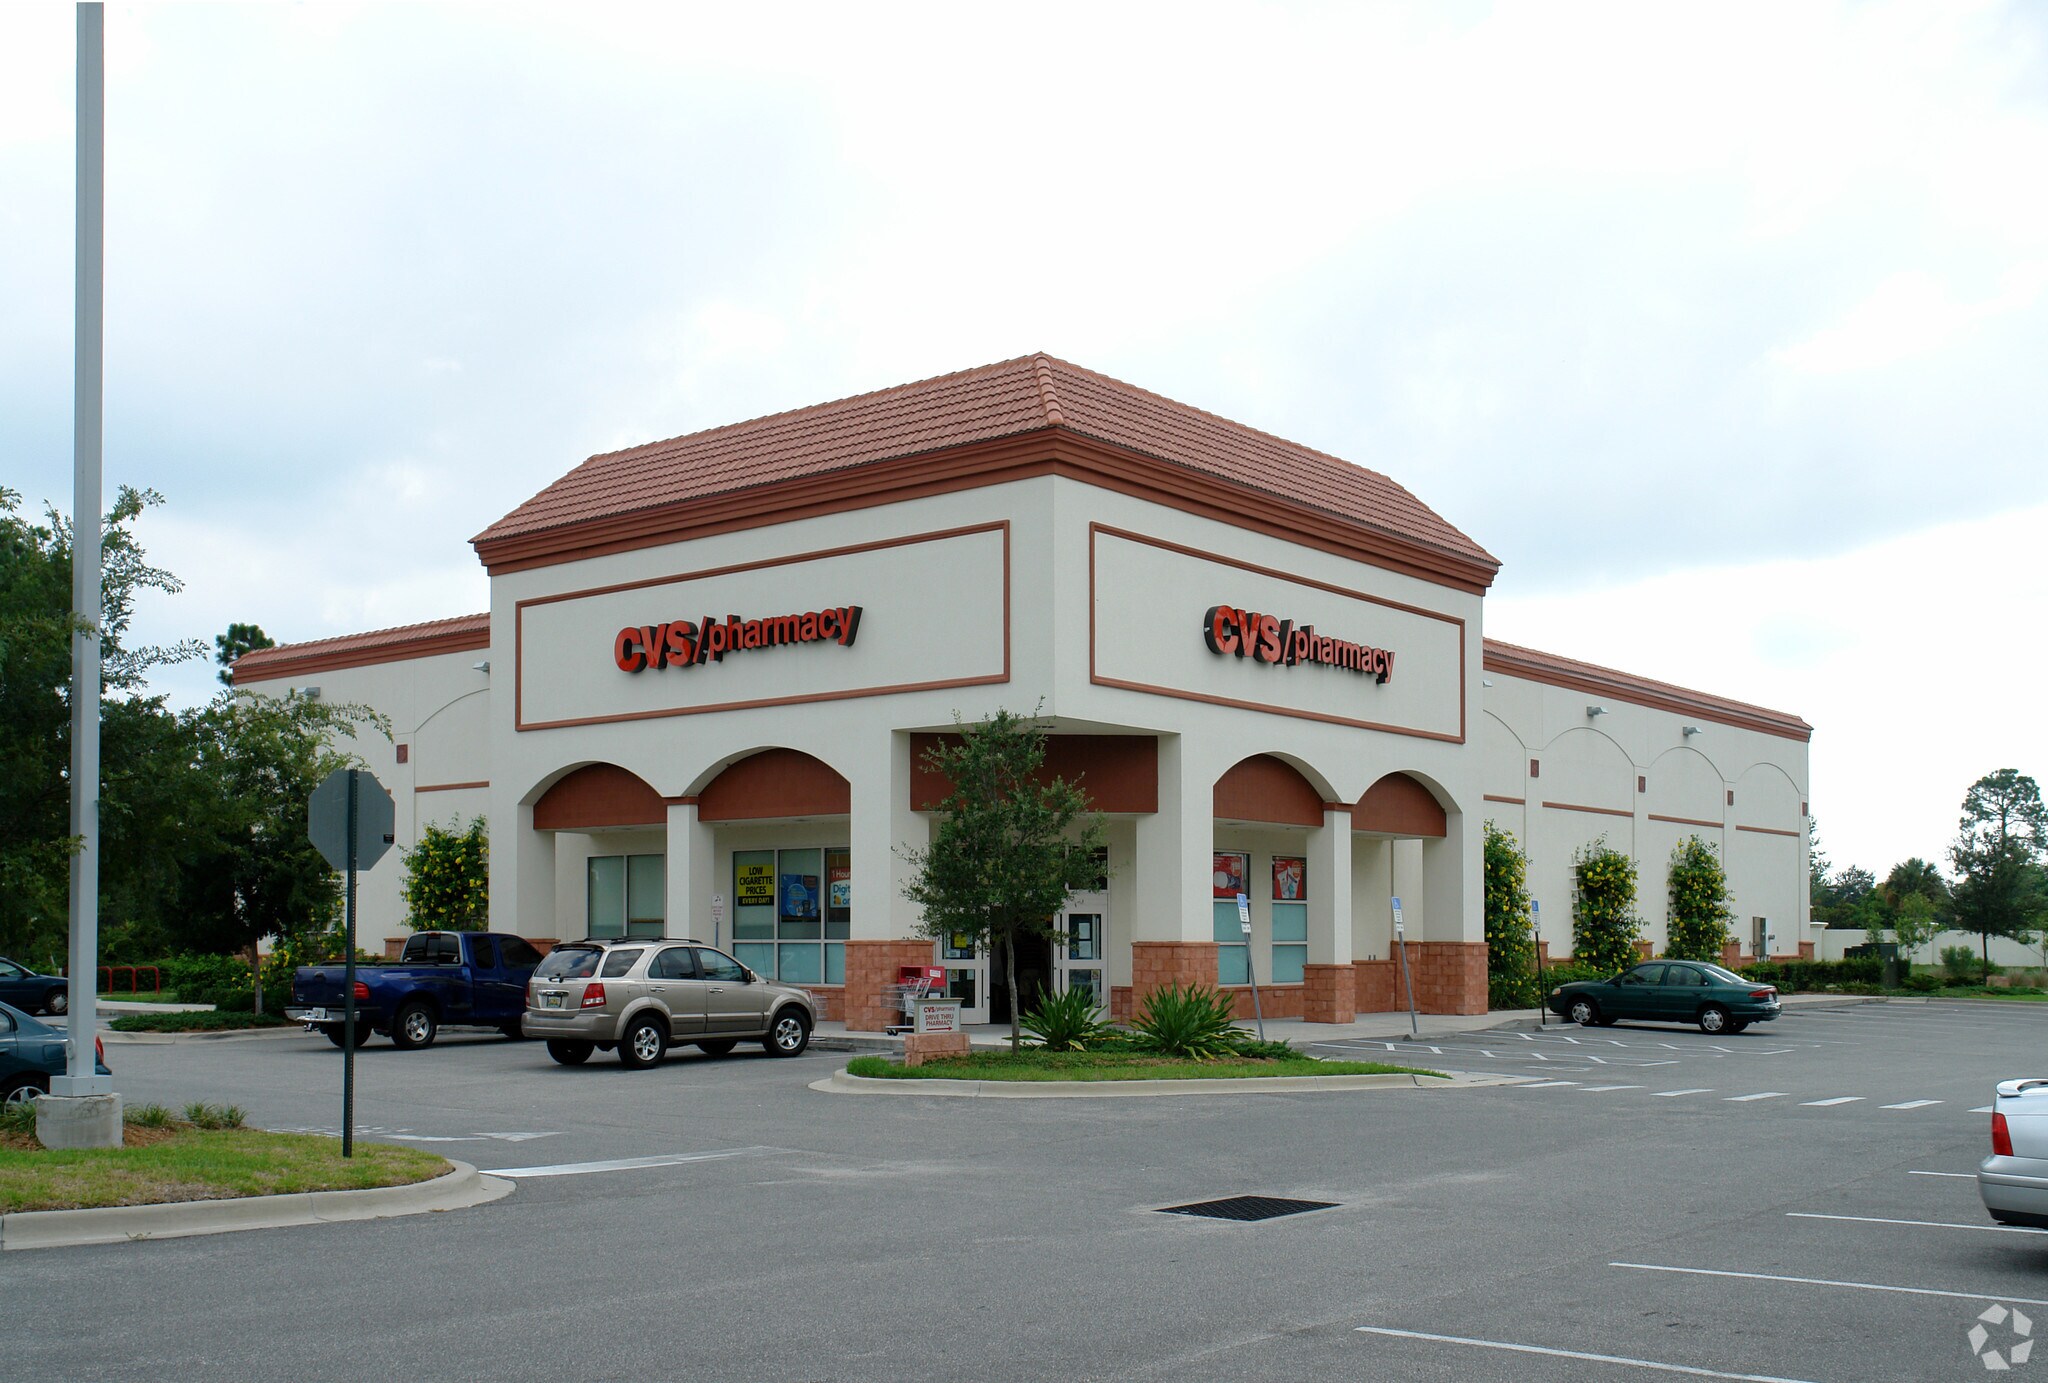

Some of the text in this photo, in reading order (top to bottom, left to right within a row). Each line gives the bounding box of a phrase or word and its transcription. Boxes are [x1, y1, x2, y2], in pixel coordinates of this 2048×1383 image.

[614, 605, 863, 673] CVS/pharmacy
[1203, 604, 1395, 684] CVS/pharmacy
[748, 866, 763, 875] LOW
[739, 875, 773, 886] CIGARETTE
[745, 885, 766, 895] PRICES
